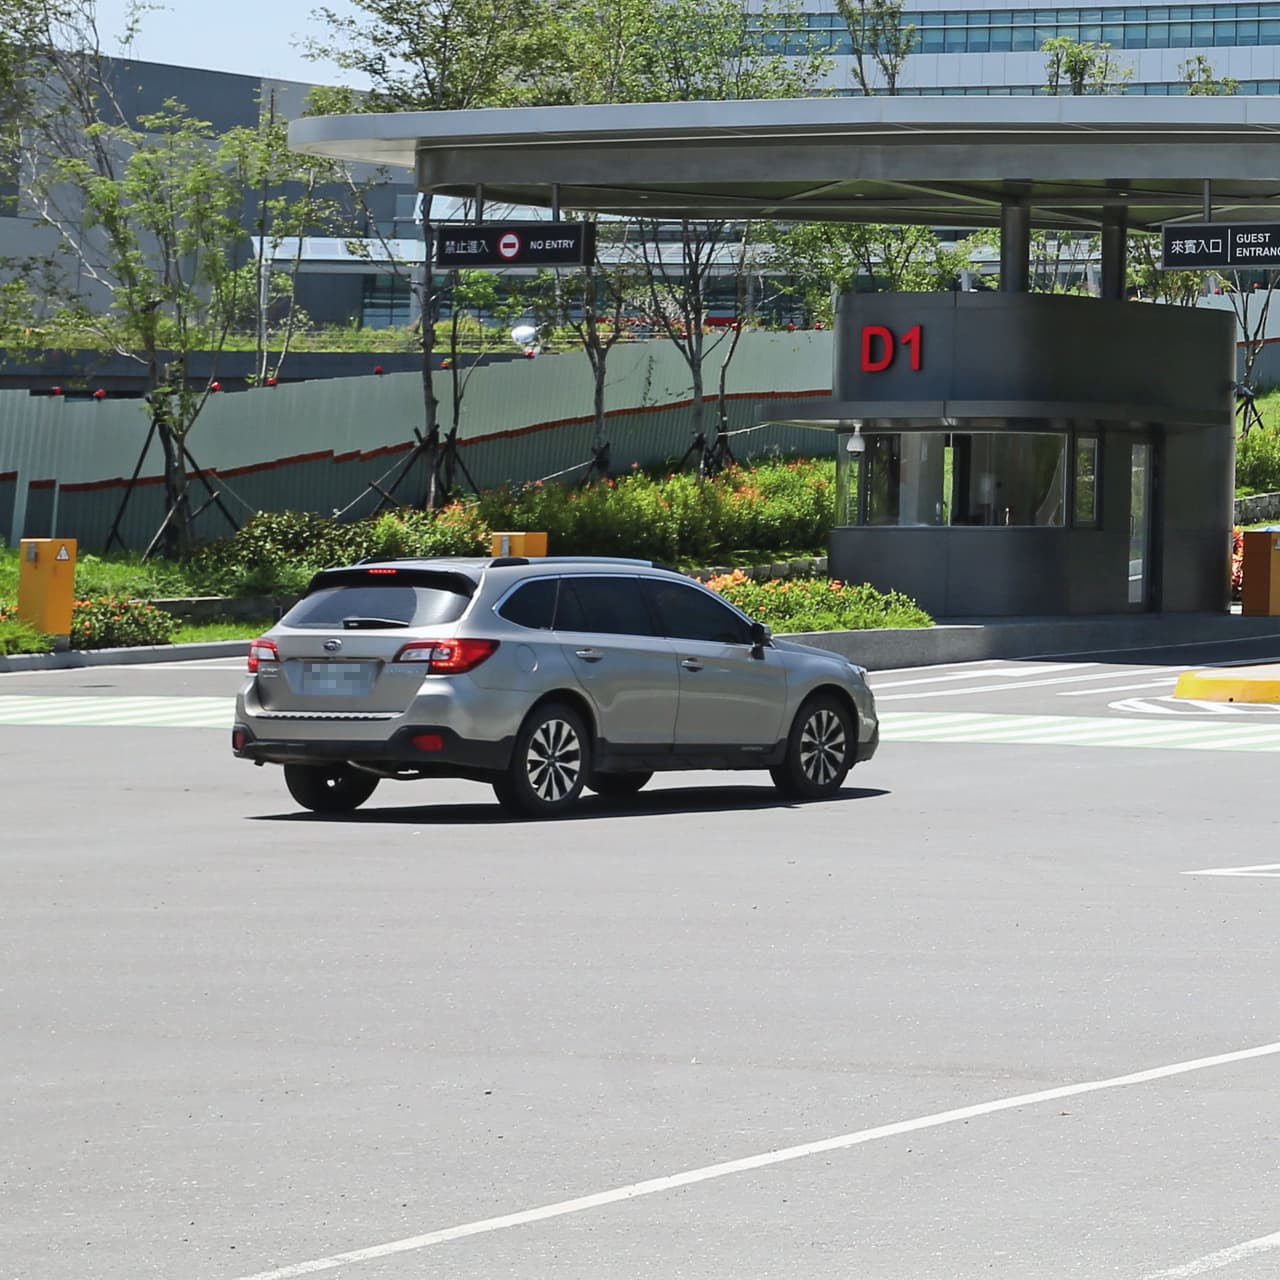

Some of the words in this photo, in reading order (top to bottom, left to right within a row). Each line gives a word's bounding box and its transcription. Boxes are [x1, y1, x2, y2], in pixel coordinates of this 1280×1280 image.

[529, 240, 544, 250] NO
[545, 239, 575, 249] ENTRY
[1236, 233, 1271, 244] GUEST
[444, 240, 489, 254] 禁止進入
[1171, 239, 1222, 254] 來賓入口
[861, 324, 922, 372] D1
